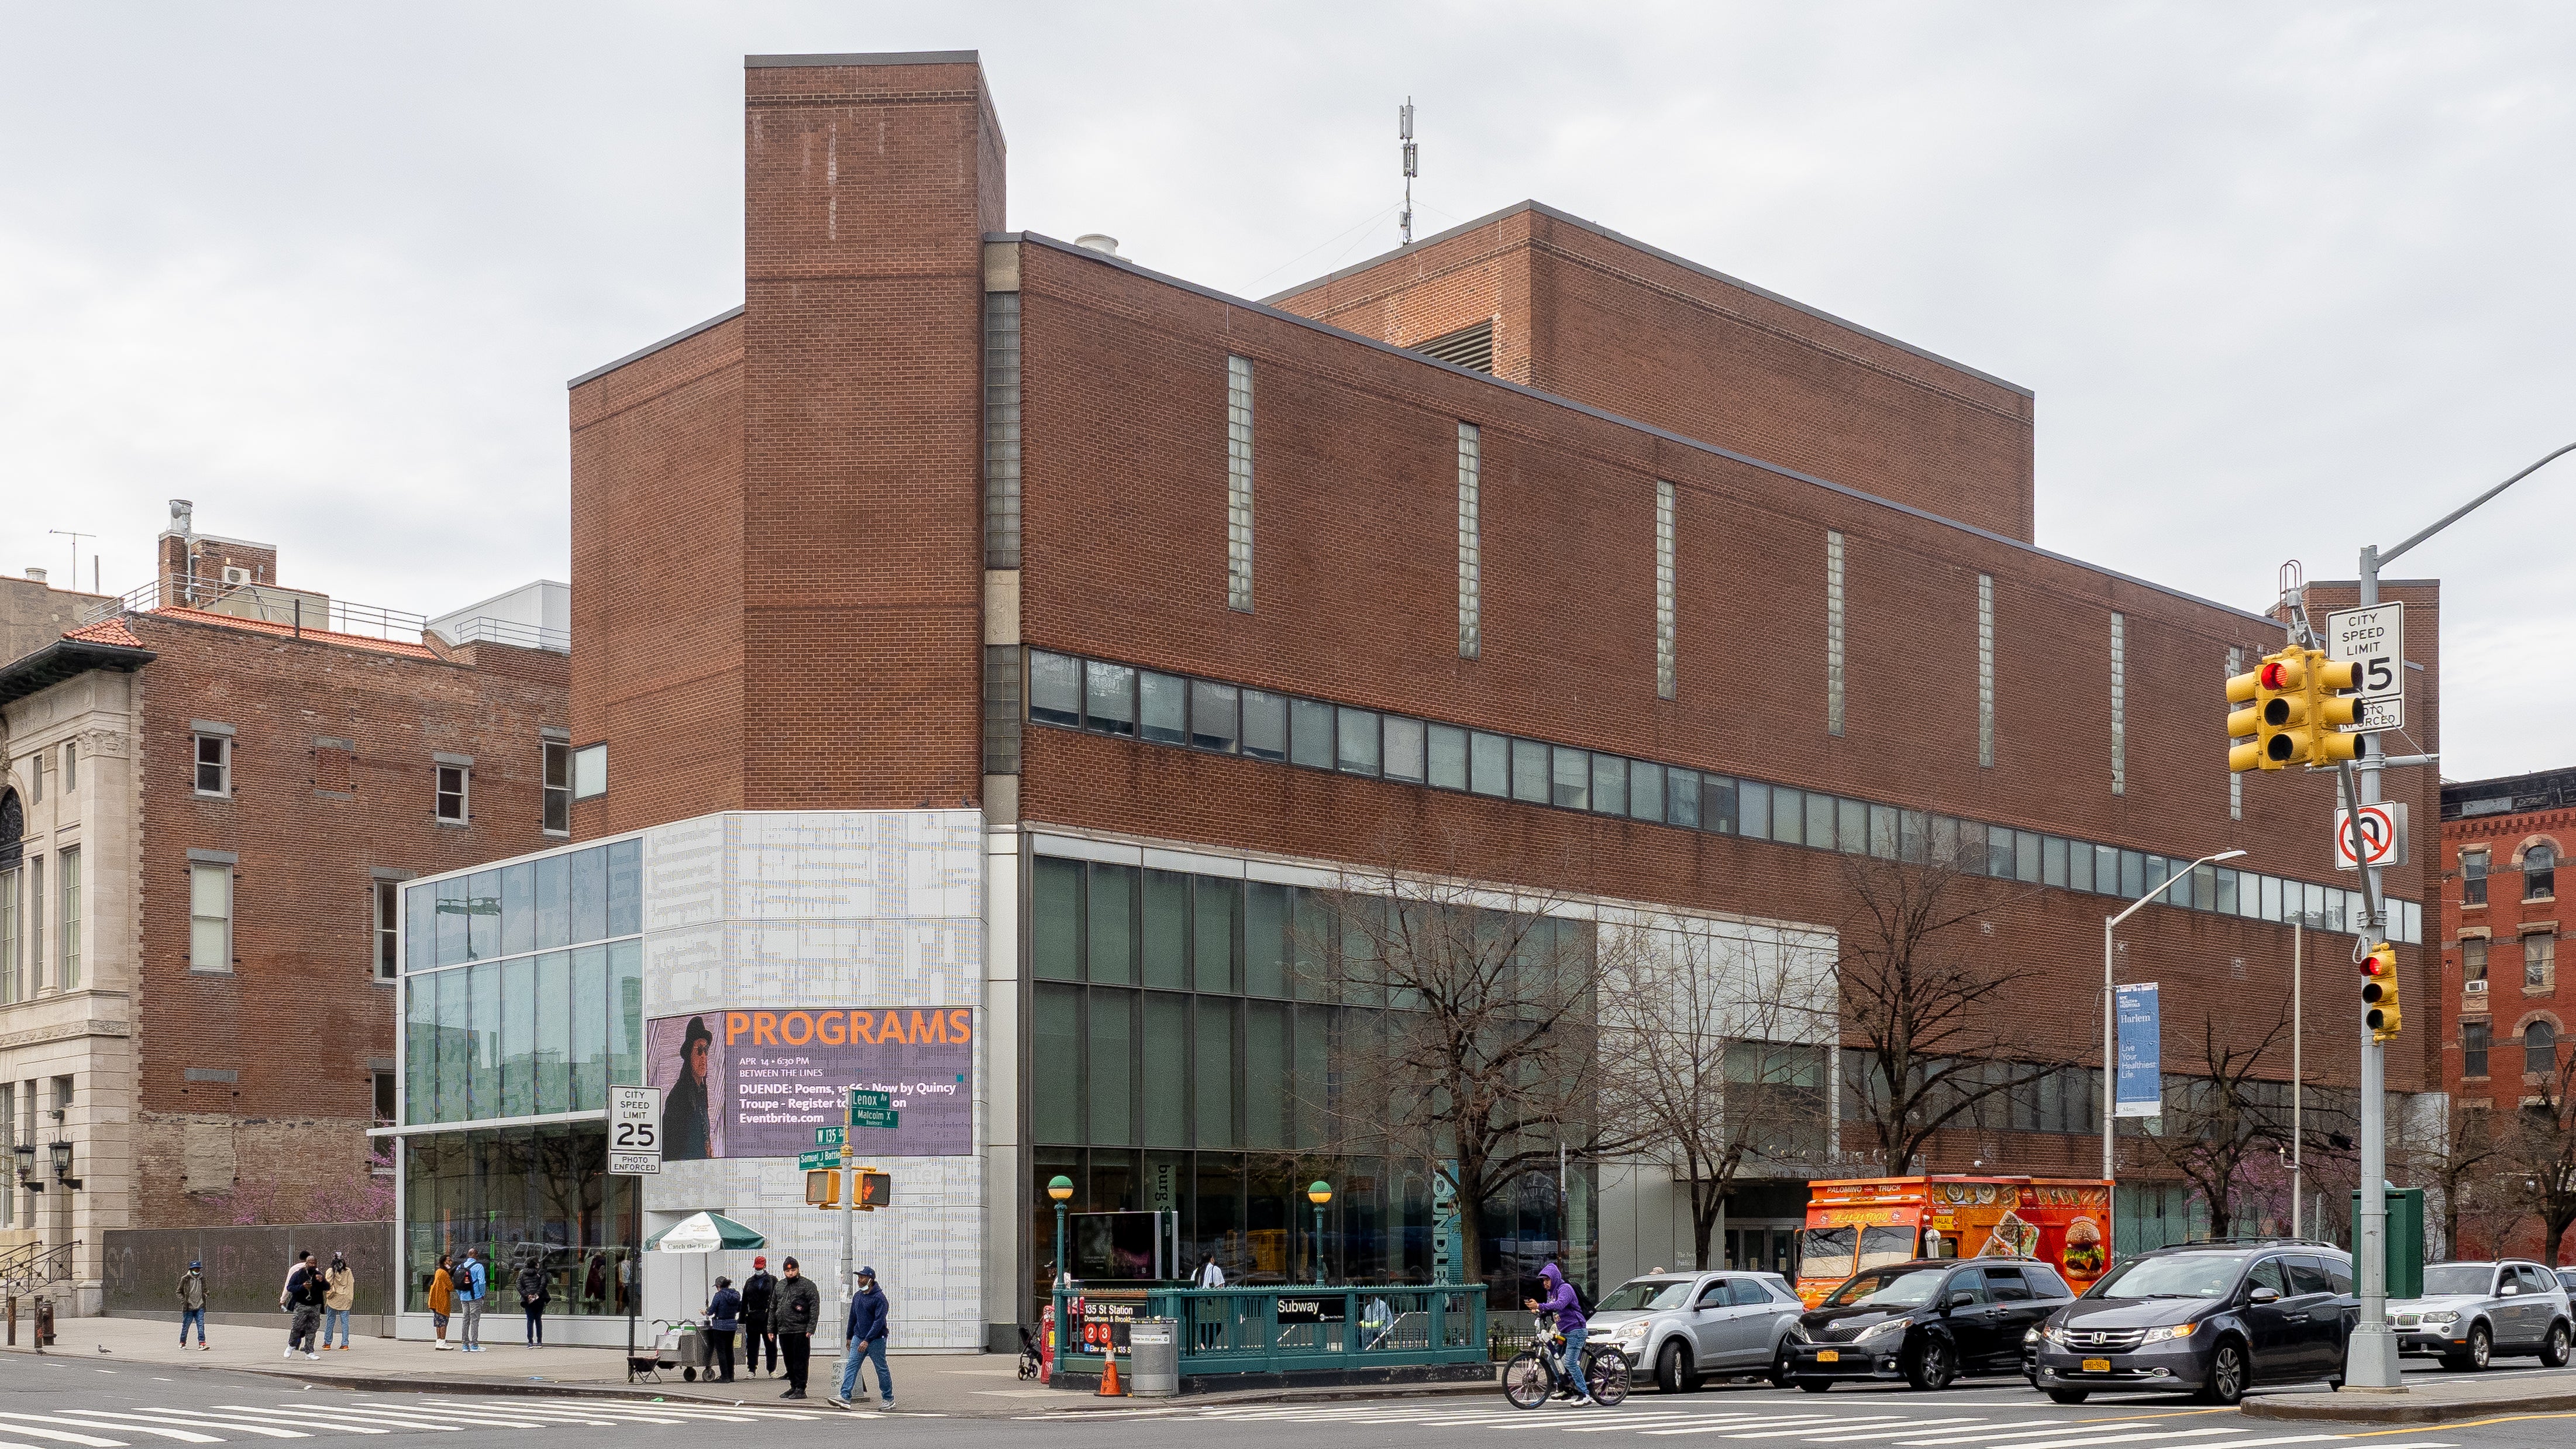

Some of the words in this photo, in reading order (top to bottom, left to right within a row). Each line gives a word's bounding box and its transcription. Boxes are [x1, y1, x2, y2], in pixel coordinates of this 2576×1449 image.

[2348, 612, 2378, 627] CITY
[2342, 627, 2384, 642] SPEED
[2347, 641, 2381, 656] LIMIT
[2121, 1014, 2151, 1023] Harlem
[726, 1010, 970, 1045] PROGRAMS
[2122, 1044, 2135, 1052] Live
[739, 1057, 756, 1065] APR
[760, 1058, 769, 1066] 14
[796, 1056, 810, 1065] PM
[2122, 1061, 2157, 1069] Healthiest
[739, 1069, 779, 1078] BETWEEN
[781, 1069, 798, 1078] THE
[800, 1069, 823, 1078] LINES
[625, 1090, 645, 1099] CITY
[739, 1083, 793, 1095] DUENDE:
[795, 1083, 835, 1096] Poems,
[872, 1083, 898, 1093] Now
[900, 1082, 914, 1096] by
[916, 1082, 957, 1096] Quincy
[620, 1100, 650, 1109] SPEED
[739, 1099, 779, 1111] Troupe
[788, 1097, 835, 1111] Register
[892, 1099, 907, 1108] on
[853, 1091, 877, 1106] Lenox
[880, 1093, 888, 1102] Av
[624, 1111, 647, 1119] LIMIT
[739, 1113, 824, 1123] Eventbrite.com
[858, 1109, 884, 1120] Malcolm
[886, 1111, 891, 1121] X
[617, 1122, 655, 1147] 25
[817, 1130, 824, 1143] W
[825, 1128, 836, 1143] 135
[838, 1128, 844, 1137] St
[800, 1152, 819, 1164] Samuel
[819, 1151, 824, 1162] J
[825, 1150, 841, 1161] Battle
[1084, 1305, 1097, 1314] 135
[1098, 1305, 1107, 1314] St
[1108, 1305, 1133, 1315] Station
[1277, 1300, 1320, 1314] Subway
[1087, 1327, 1094, 1339] 2
[1101, 1327, 1108, 1340] 3
